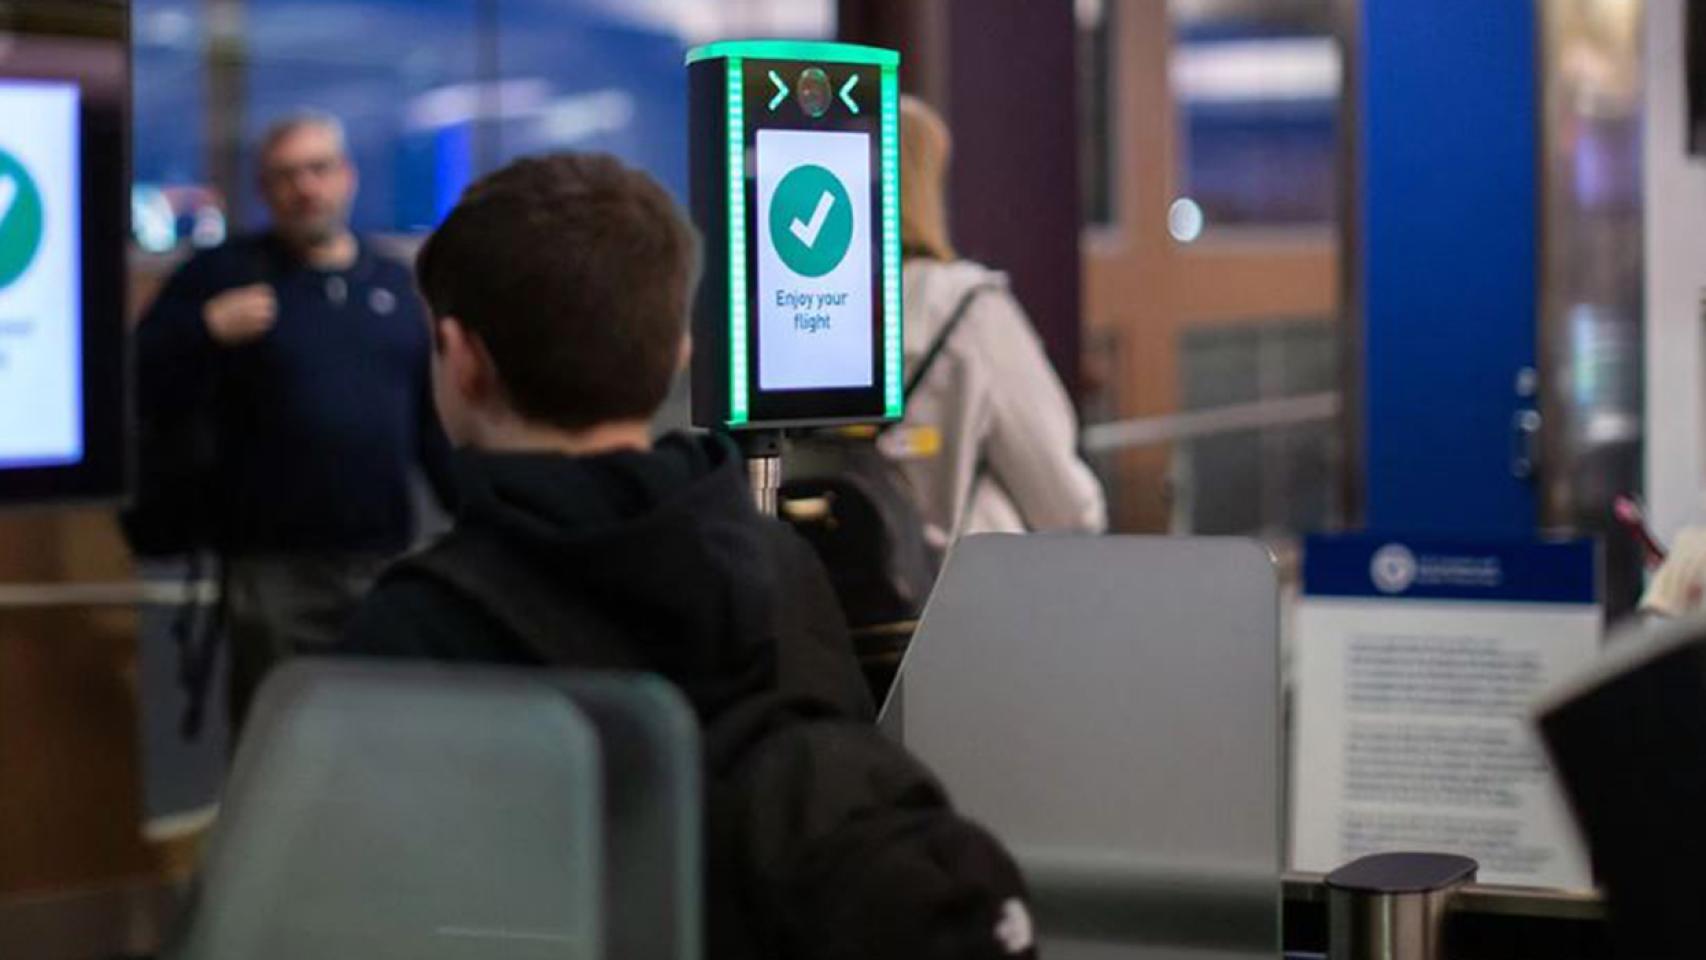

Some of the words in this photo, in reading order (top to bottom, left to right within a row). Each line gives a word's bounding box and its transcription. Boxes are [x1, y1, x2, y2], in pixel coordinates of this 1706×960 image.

[775, 289, 813, 310] Enjoy
[815, 292, 848, 310] your
[793, 313, 831, 333] flight
